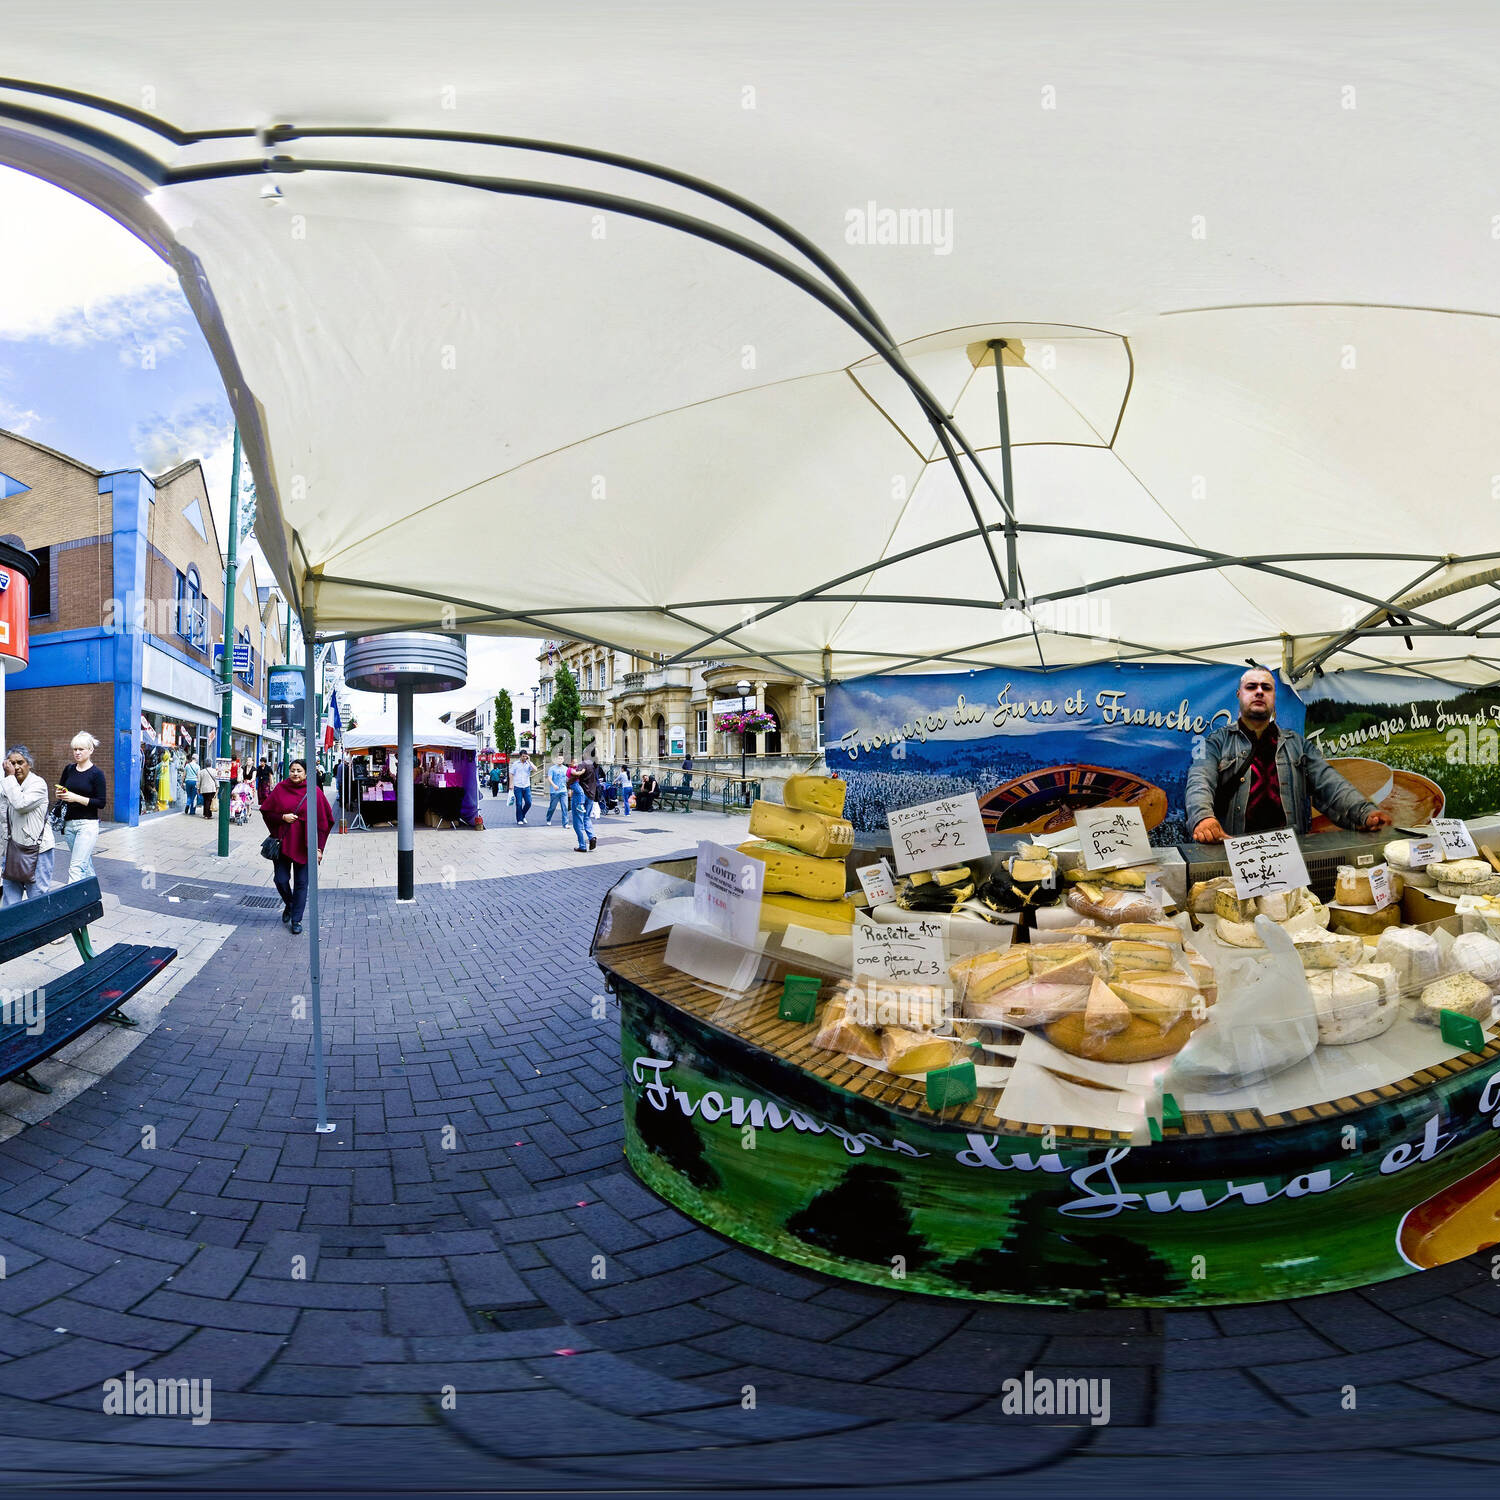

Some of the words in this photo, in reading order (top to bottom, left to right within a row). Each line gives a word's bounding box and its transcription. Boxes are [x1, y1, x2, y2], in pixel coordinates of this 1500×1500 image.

[840, 713, 948, 760] Fromages
[953, 694, 985, 726] du
[992, 682, 1058, 728] Jura
[1064, 689, 1088, 715] et
[1410, 702, 1432, 730] du
[1436, 701, 1472, 733] Jura
[1475, 707, 1488, 726] et
[905, 840, 926, 860] for
[1094, 840, 1116, 860] for
[712, 865, 737, 882] COMTE
[1241, 868, 1259, 883] for
[857, 956, 879, 965] one
[633, 1056, 930, 1158] Fromages
[956, 1132, 1072, 1174] du
[1057, 1146, 1354, 1219] Jura
[1380, 1113, 1458, 1175] et
